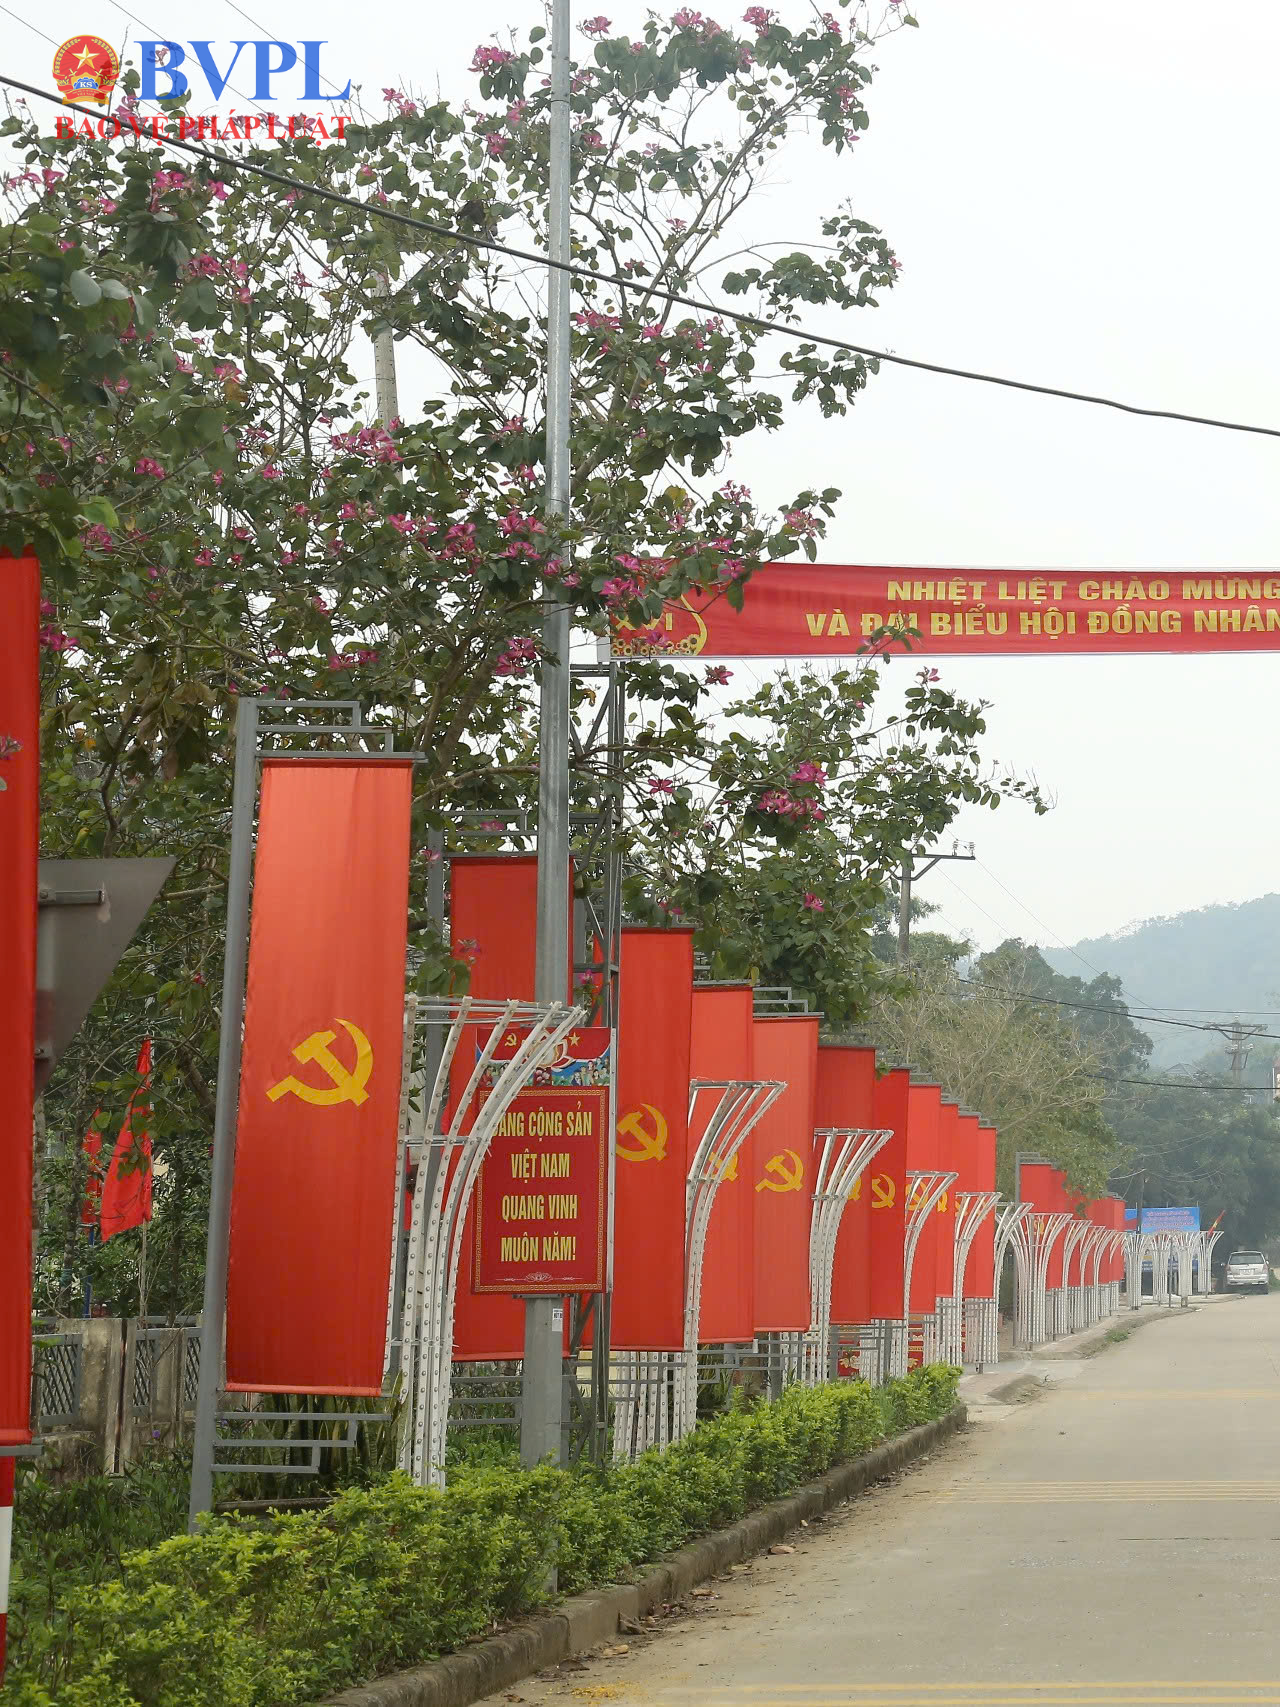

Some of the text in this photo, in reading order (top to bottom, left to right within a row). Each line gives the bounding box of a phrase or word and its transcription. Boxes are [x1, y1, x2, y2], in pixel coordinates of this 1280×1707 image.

[887, 577, 987, 606] NHIỆT
[998, 576, 1067, 605] LIỆT
[1078, 576, 1170, 601] CHÀO
[805, 608, 851, 636] VÀ
[930, 602, 1008, 636] BIỂU
[1019, 606, 1076, 639] HỘI
[1087, 603, 1182, 634] ĐỒNG
[528, 1106, 563, 1142] CỘNG
[566, 1101, 592, 1137] SẢN
[511, 1148, 570, 1184] VIỆT NAM
[502, 1194, 577, 1222] QUANG VINH
[500, 1231, 576, 1262] MUÔN NĂM!
